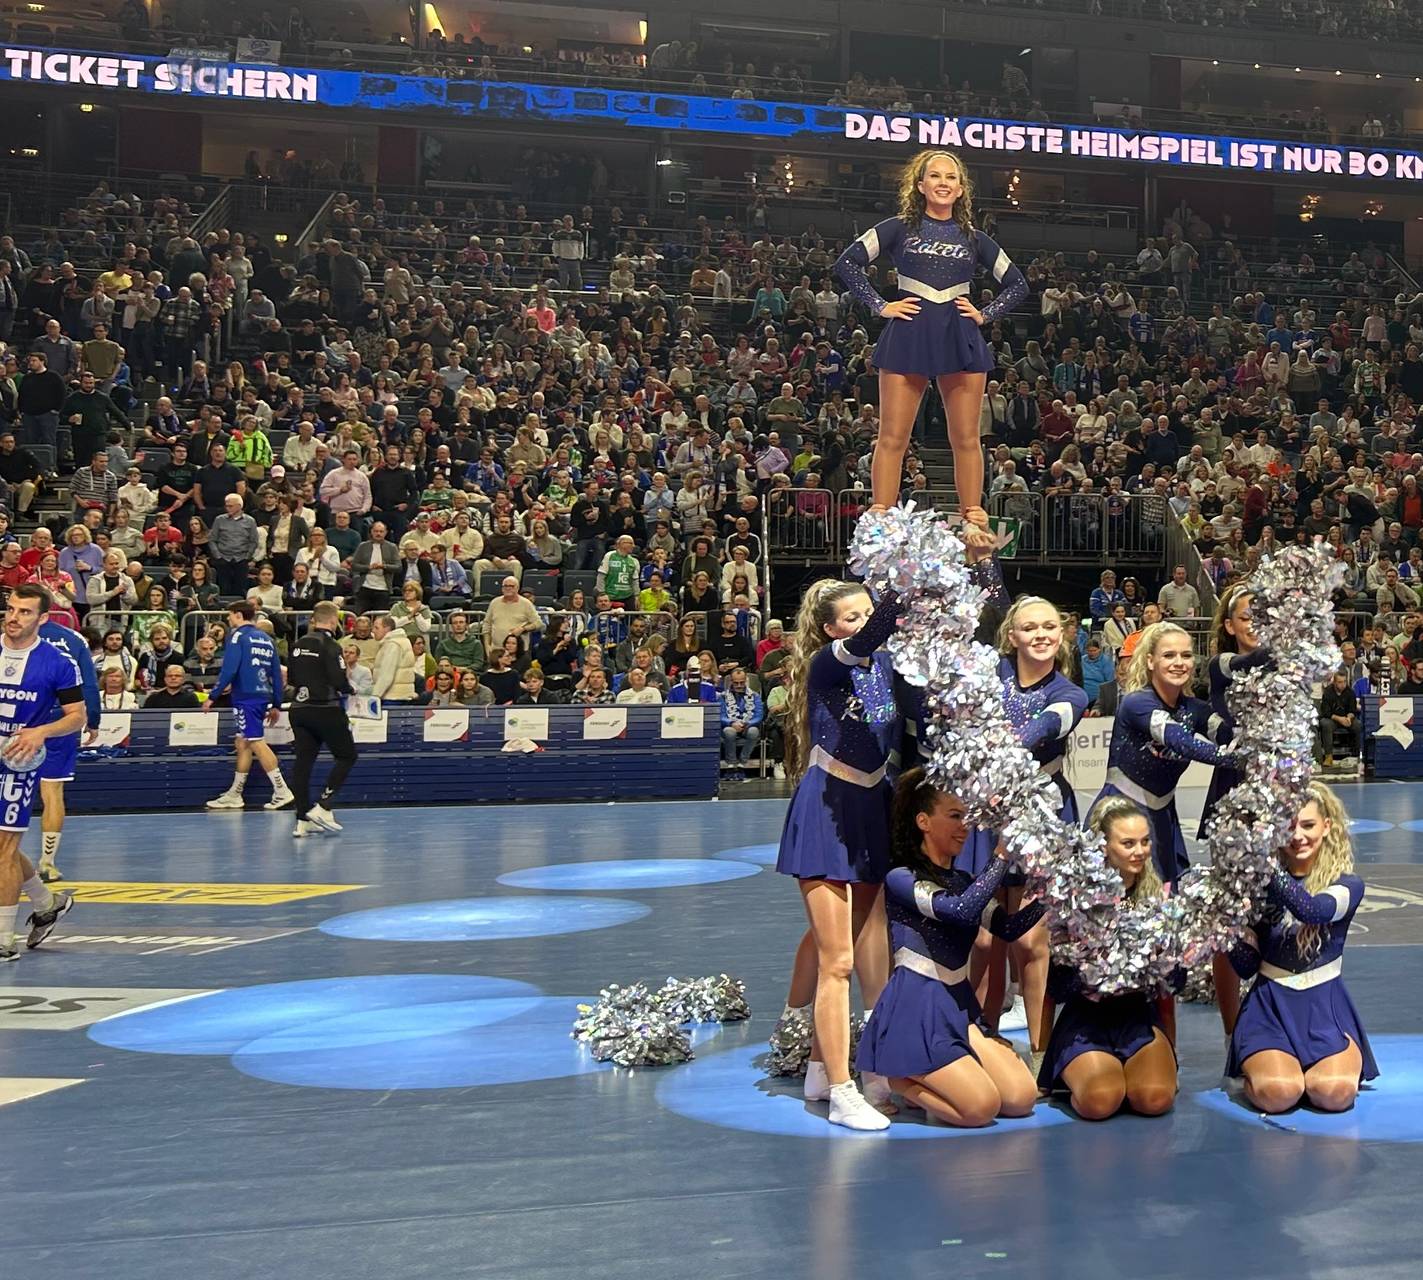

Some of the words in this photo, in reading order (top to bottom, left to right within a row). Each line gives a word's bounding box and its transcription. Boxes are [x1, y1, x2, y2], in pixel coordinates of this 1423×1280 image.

[5, 48, 145, 89] TICKET
[154, 63, 318, 101] SICHERN
[845, 113, 911, 143] DAS
[918, 117, 1063, 154] NÄCHSTE
[1070, 130, 1224, 167] HEIMSPIEL
[1230, 142, 1277, 170] IST
[1283, 146, 1343, 175] NUR
[1349, 151, 1389, 178] 30
[5, 803, 19, 825] 6
